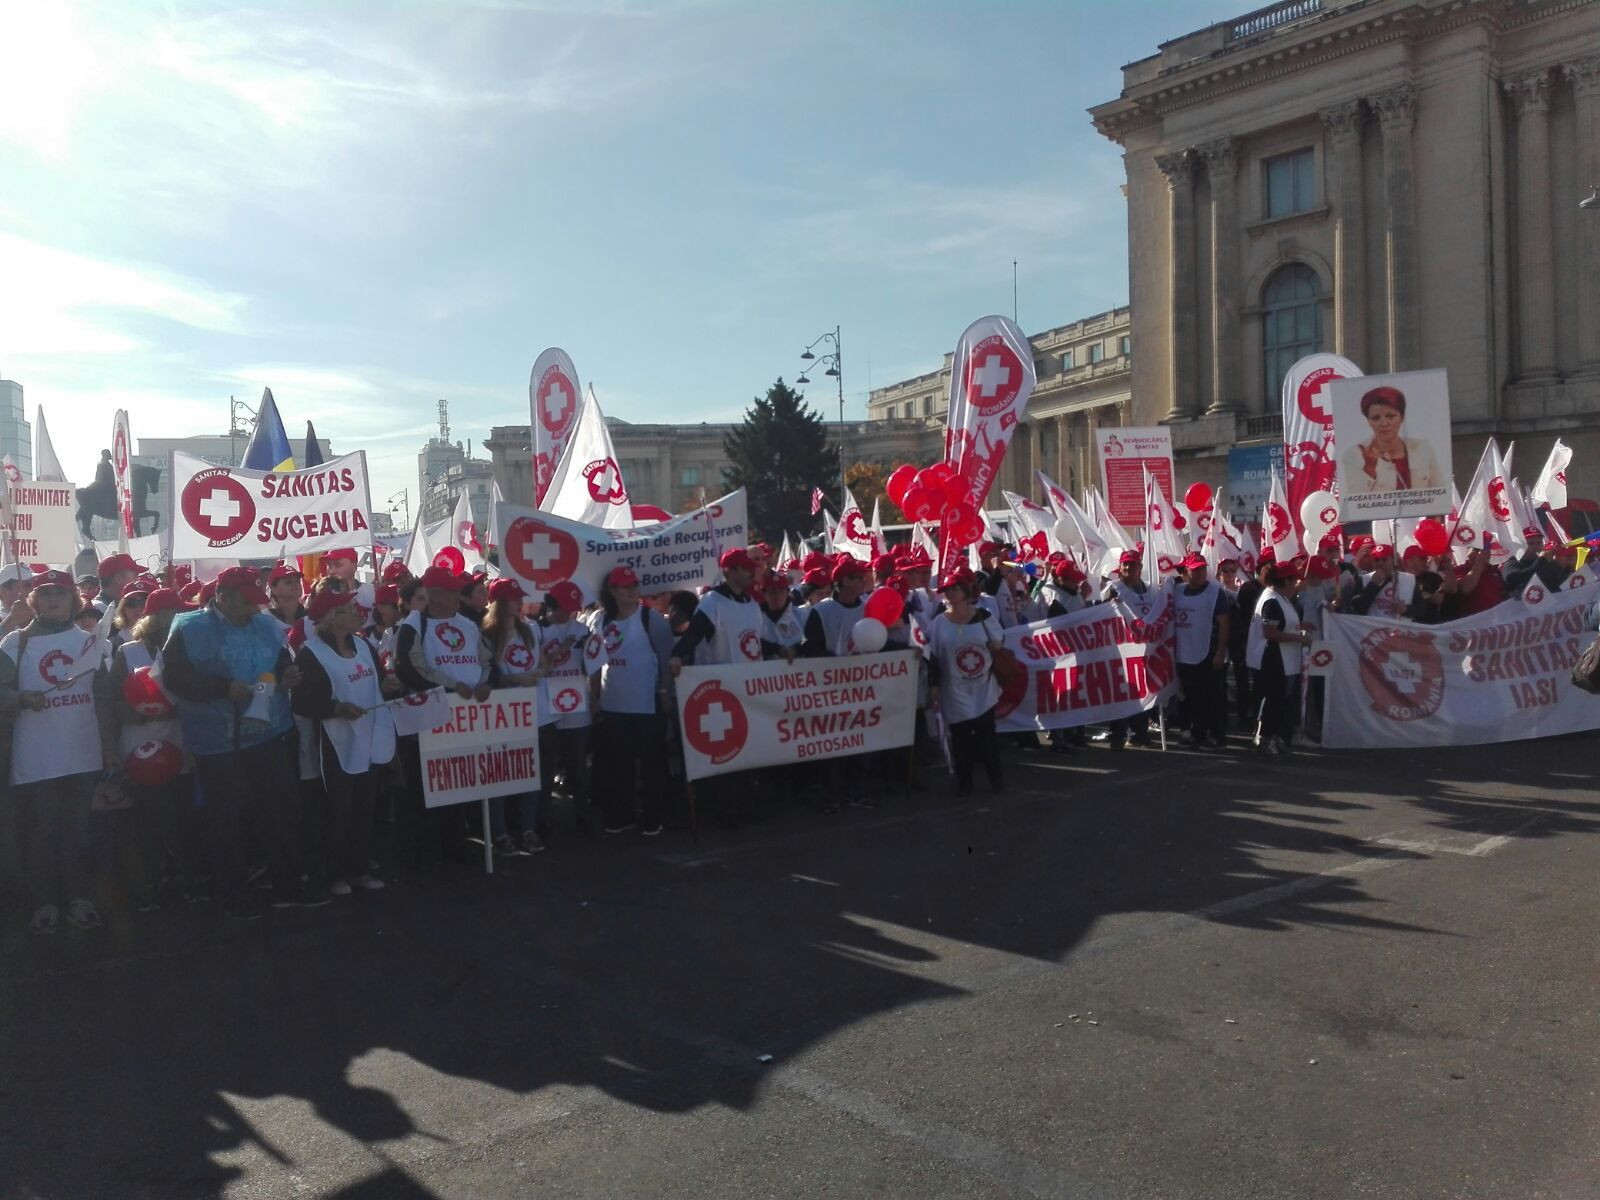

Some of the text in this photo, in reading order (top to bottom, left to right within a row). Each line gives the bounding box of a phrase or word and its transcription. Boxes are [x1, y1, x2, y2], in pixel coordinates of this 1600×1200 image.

[1269, 447, 1284, 457] GA
[194, 469, 228, 484] SANITAS
[260, 468, 356, 499] SANITAS
[15, 488, 70, 507] DEMNITATE
[211, 532, 243, 547] SUCEAVA
[256, 508, 369, 543] SUCEAVA
[654, 534, 671, 548] de
[642, 565, 704, 586] Botosani
[1448, 604, 1586, 654] SINDICATU
[1468, 637, 1581, 683] SANITAS
[745, 660, 908, 697] UNIUNEA SINDICALA
[1508, 677, 1559, 710] IASI
[783, 685, 876, 714] JUDETEANA
[776, 706, 882, 743] SANITAS
[797, 733, 865, 759] BOTOSANI
[427, 743, 536, 793] PENTRU SĂNĂTATE
